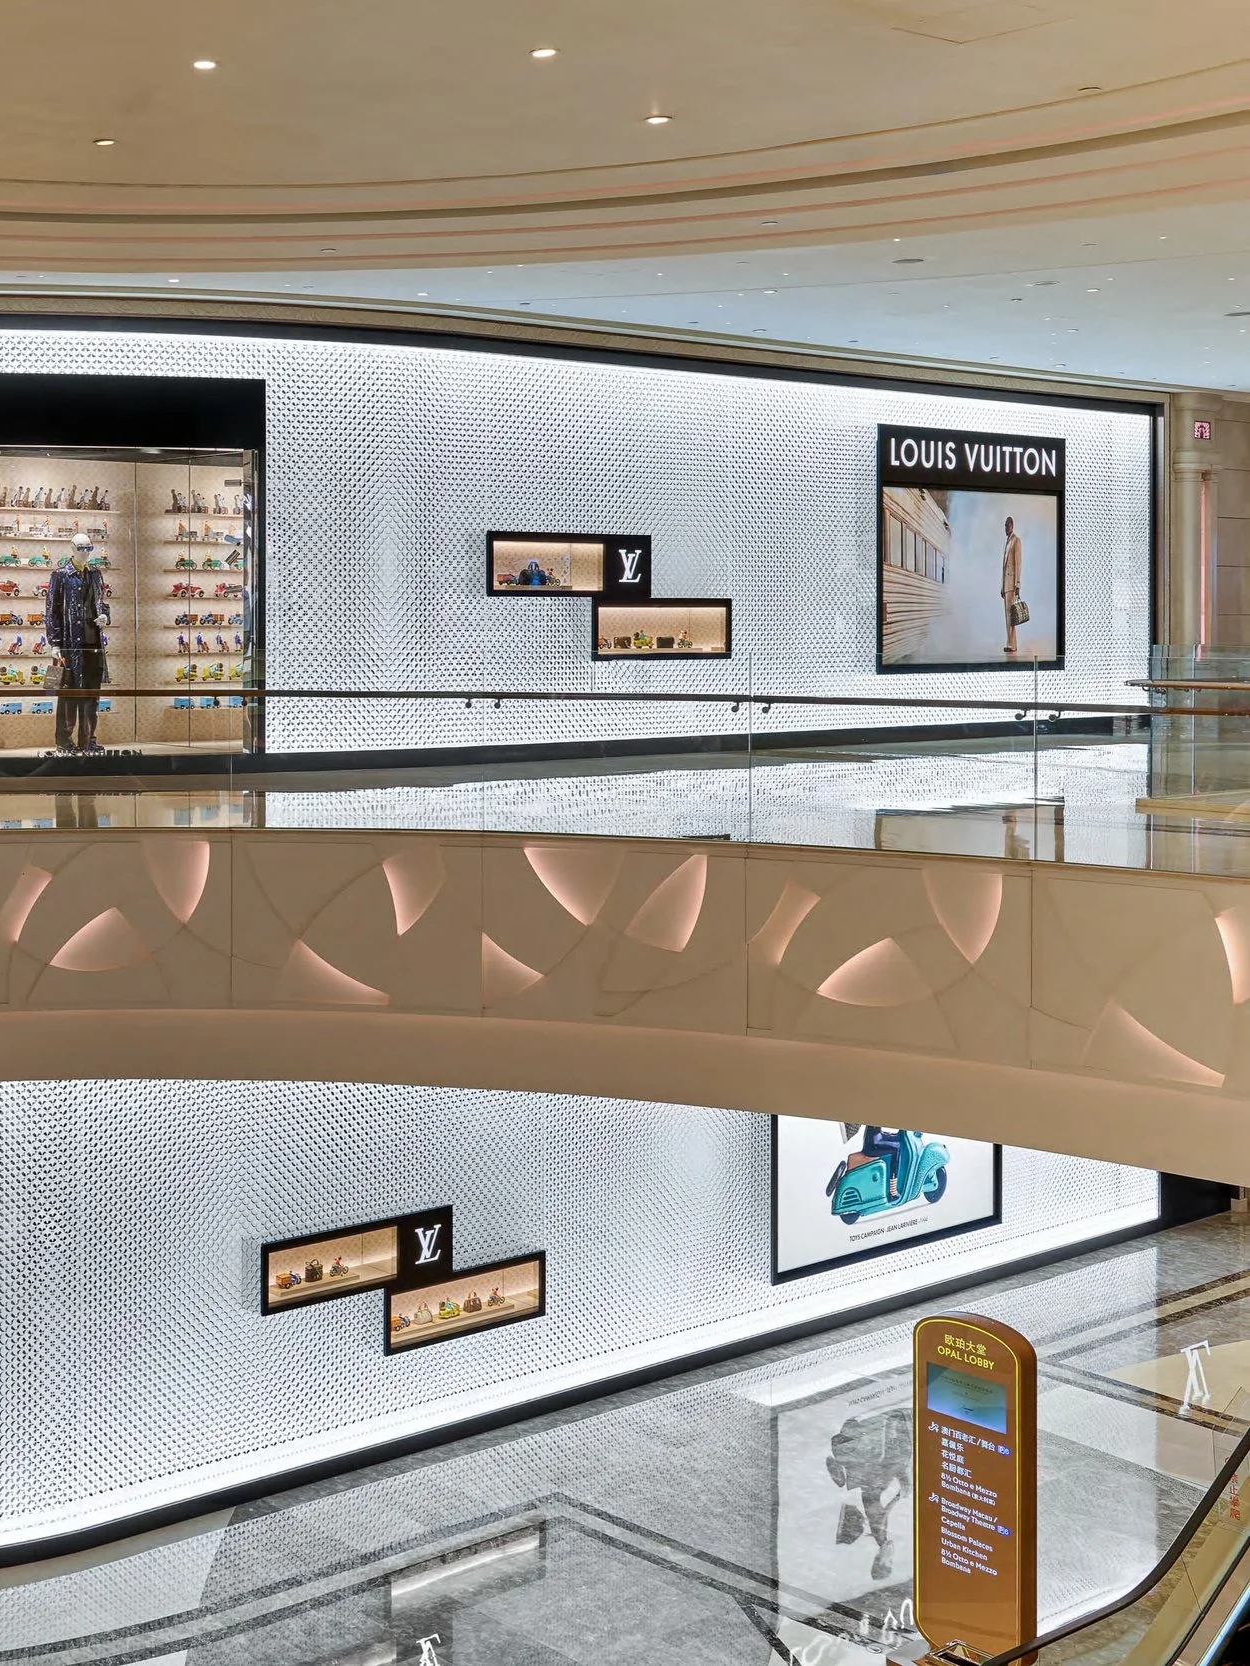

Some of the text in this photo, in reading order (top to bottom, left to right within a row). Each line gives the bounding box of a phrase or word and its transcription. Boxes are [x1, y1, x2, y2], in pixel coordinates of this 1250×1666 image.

[890, 437, 1057, 478] LOUIS VUITTON
[618, 549, 643, 583] LV
[414, 1223, 442, 1265] LV
[849, 1231, 860, 1242] TOYS
[860, 1227, 885, 1240] CAMPAIGN
[944, 1334, 987, 1356] 欧珀大堂
[937, 1345, 995, 1370] OPAL LOBBY
[941, 1480, 971, 1497] Bombana
[952, 1476, 969, 1488] Otto
[975, 1484, 998, 1498] Mezzo
[941, 1497, 971, 1515] Broadway
[972, 1508, 993, 1523] Macau
[941, 1505, 970, 1523] Broadway
[971, 1515, 996, 1531] Theatre
[941, 1516, 966, 1531] Capella
[941, 1526, 968, 1542] Blossom
[941, 1537, 988, 1561] Urban Kitchen
[941, 1556, 971, 1574] Bombana
[952, 1552, 969, 1565] Otto
[975, 1561, 998, 1575] Mezzo
